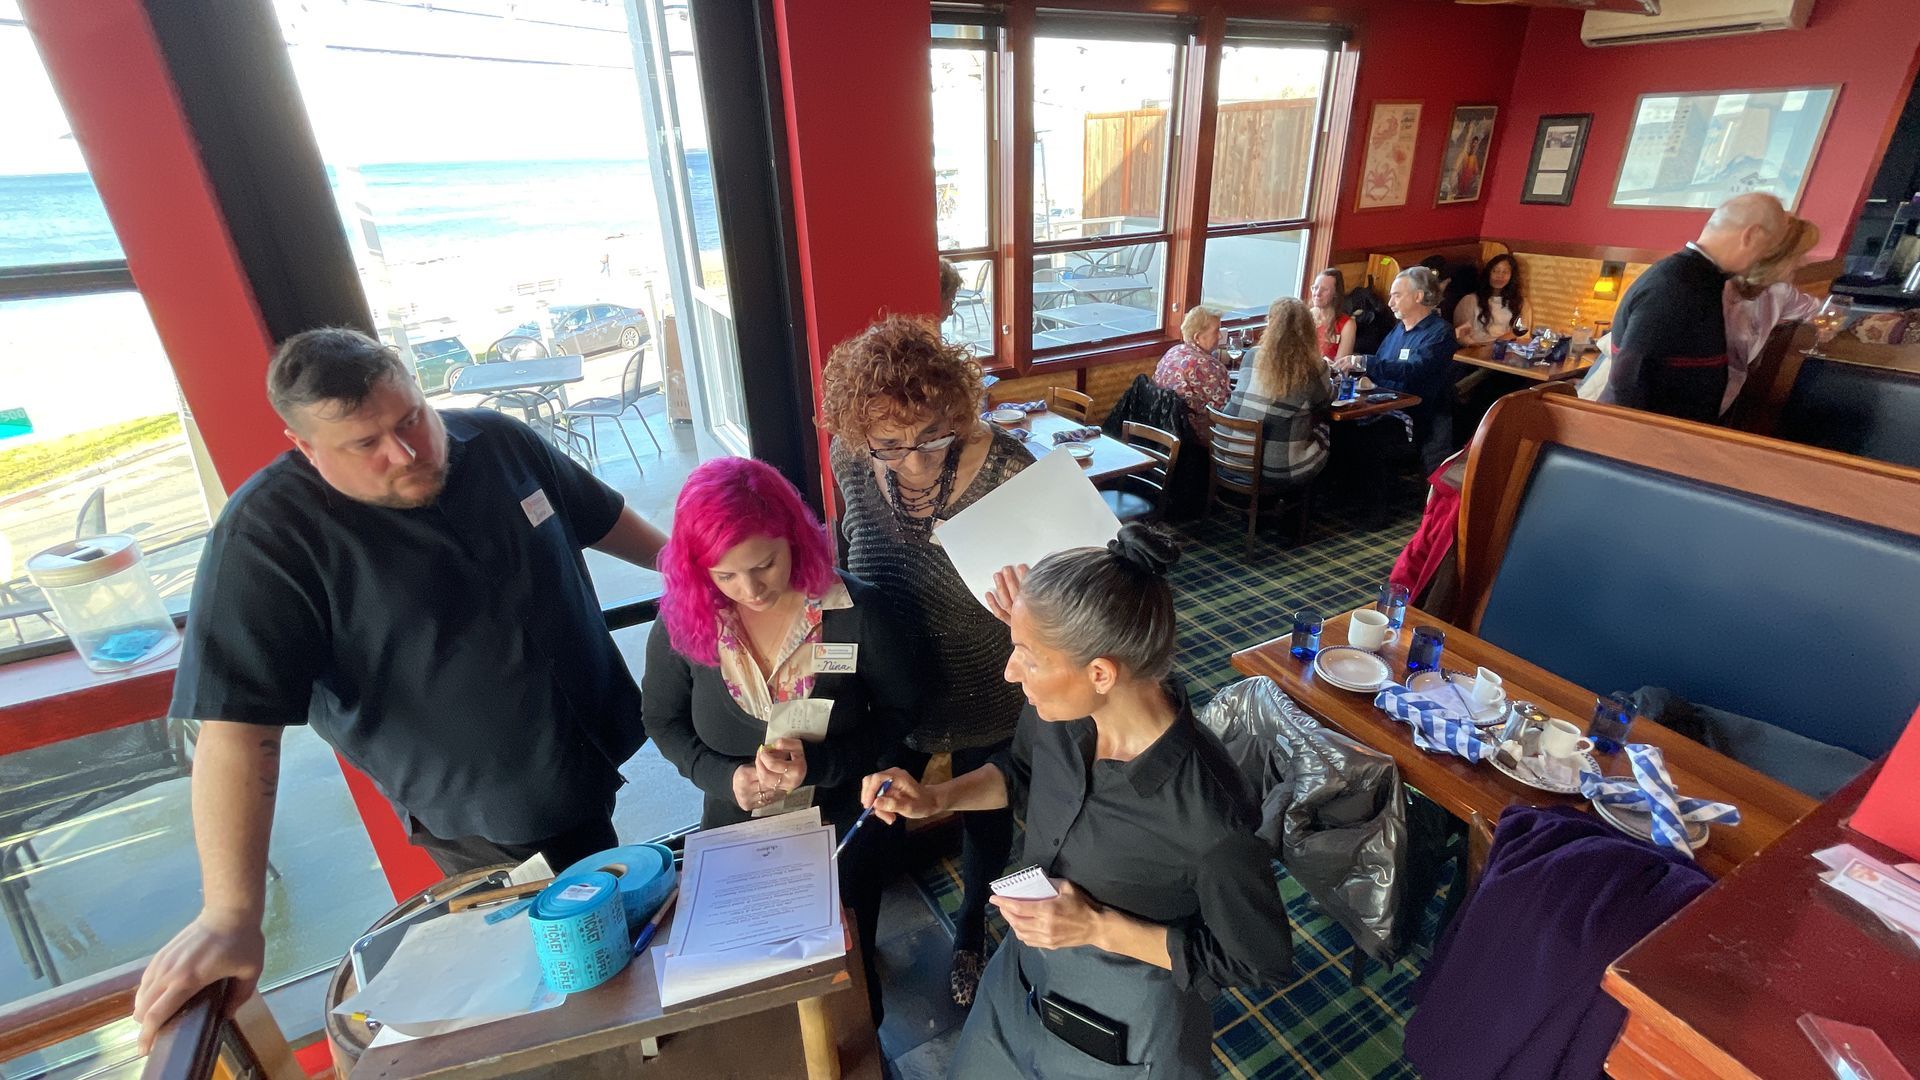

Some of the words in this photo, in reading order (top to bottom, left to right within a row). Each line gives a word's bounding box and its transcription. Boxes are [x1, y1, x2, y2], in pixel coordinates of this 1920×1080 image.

[821, 660, 850, 671] Nina
[546, 924, 563, 953] TICKET
[584, 912, 601, 944] TICKET
[558, 961, 572, 990] RAFFLE
[595, 948, 609, 979] RAFFLE
